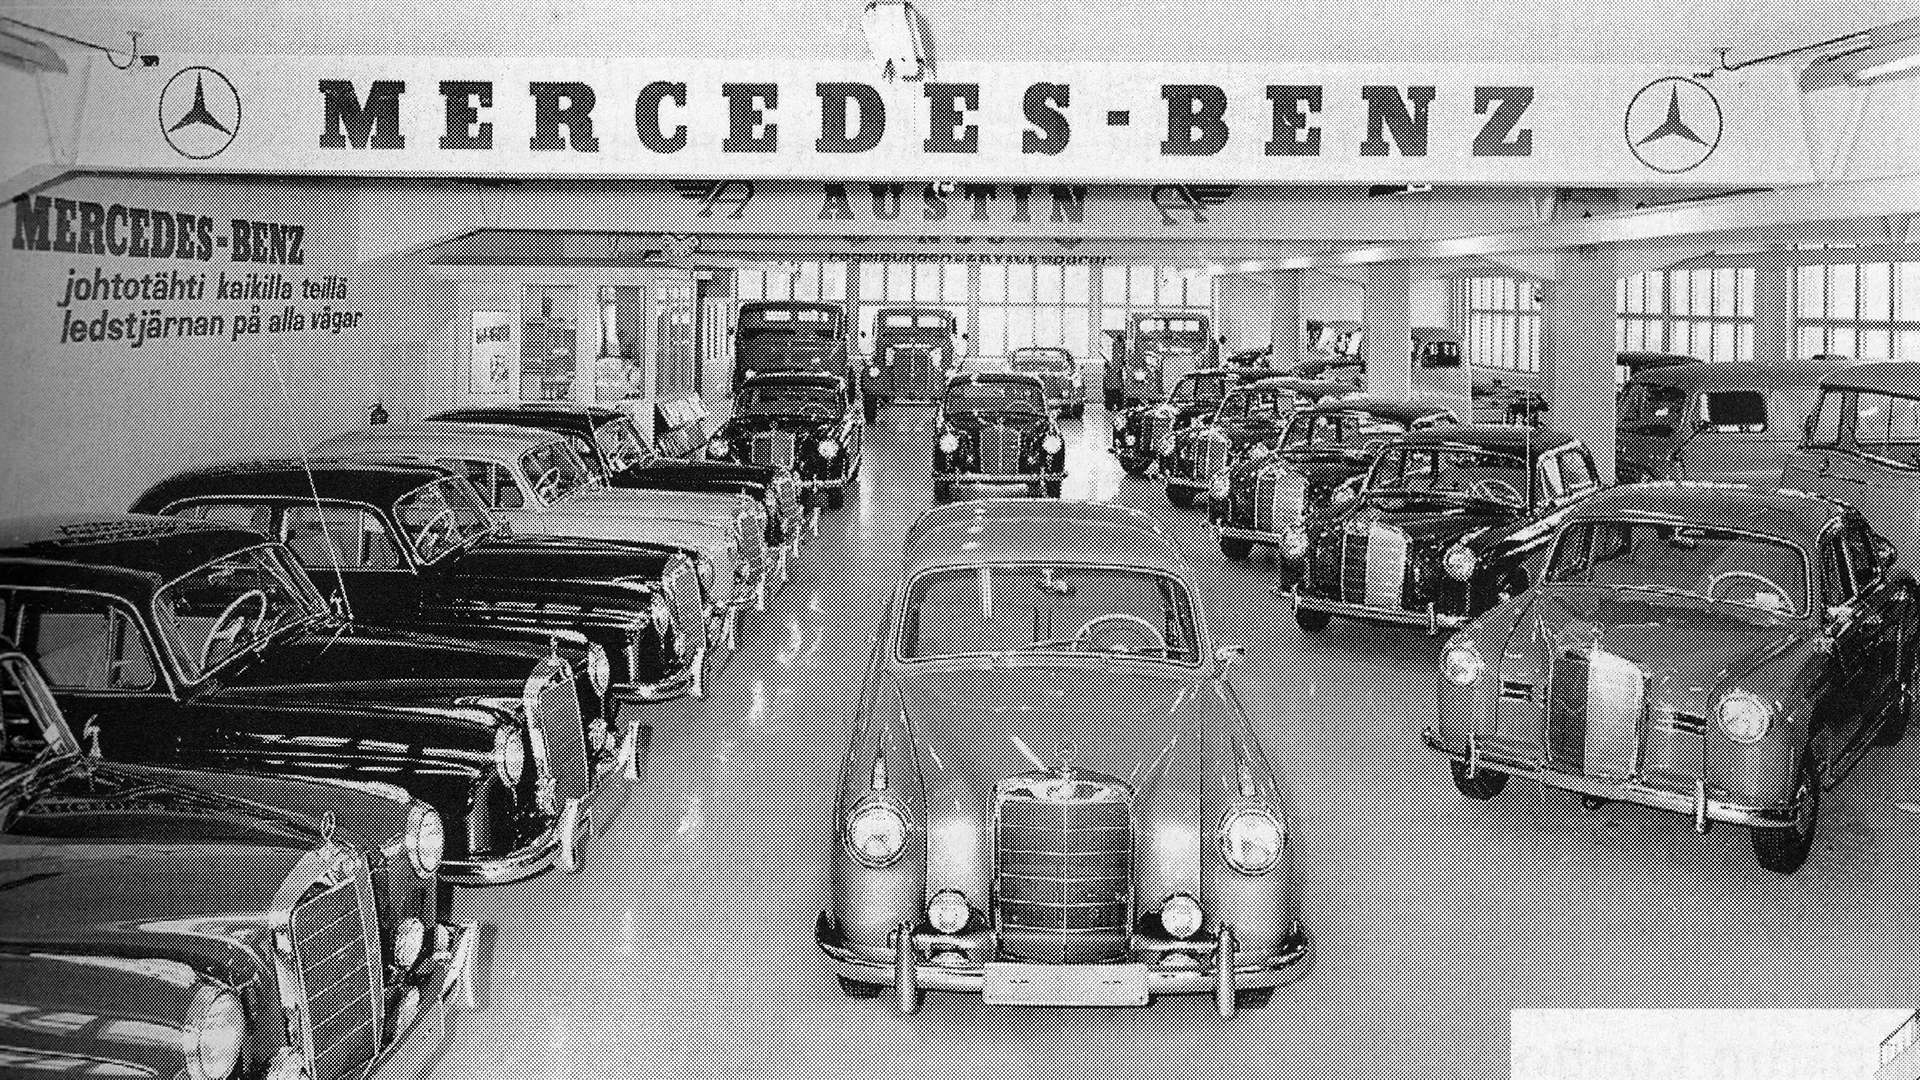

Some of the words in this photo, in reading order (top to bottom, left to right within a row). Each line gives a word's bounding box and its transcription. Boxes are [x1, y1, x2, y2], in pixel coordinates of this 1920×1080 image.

[319, 81, 1533, 156] MERCEDES-BENZ
[818, 183, 1087, 221] AUSTIN
[12, 196, 304, 264] MERCEDES-BENZ
[57, 268, 206, 307] johtotähti
[217, 272, 293, 301] kaikilla
[302, 275, 348, 300] teillä
[60, 309, 224, 349] ledstjärnan
[232, 306, 261, 342] på
[269, 306, 305, 333] alla
